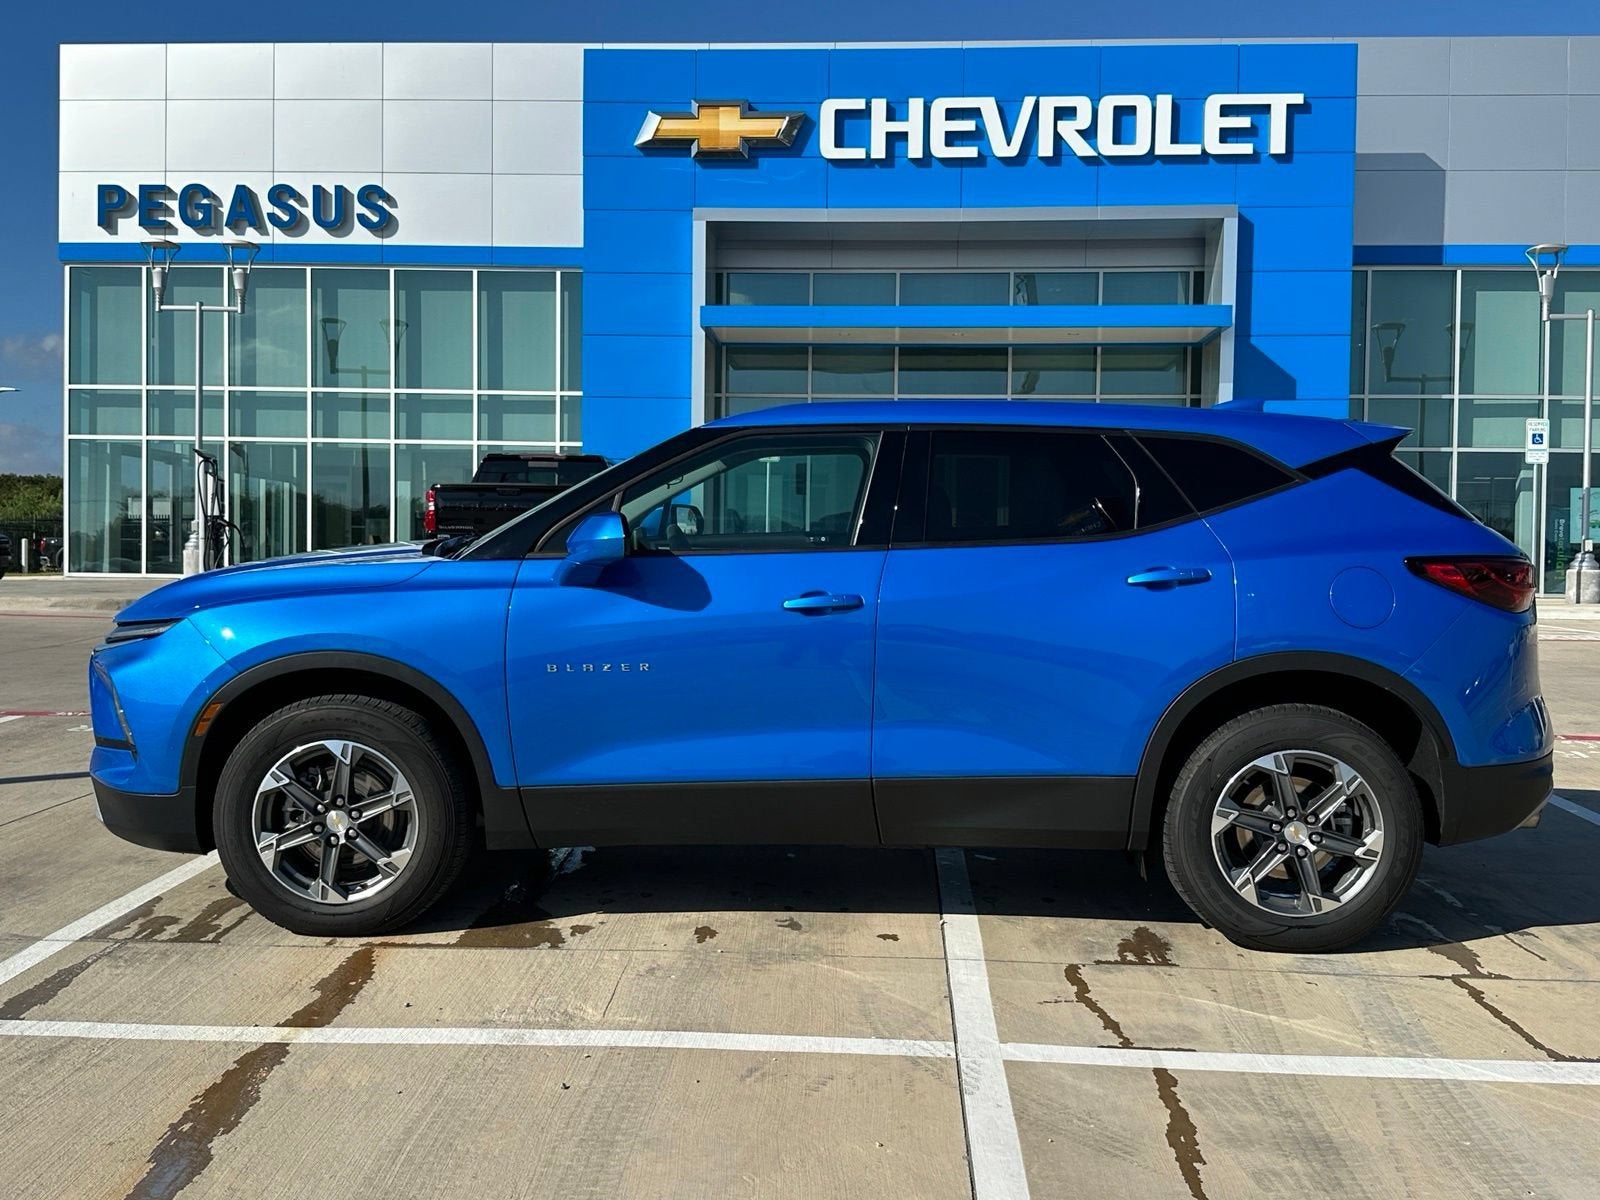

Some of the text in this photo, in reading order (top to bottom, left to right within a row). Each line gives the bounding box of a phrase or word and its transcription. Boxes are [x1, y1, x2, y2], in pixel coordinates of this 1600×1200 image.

[819, 93, 1305, 160] CHEVROLET
[97, 183, 393, 231] PEGASUS
[546, 662, 650, 673] BLAZER
